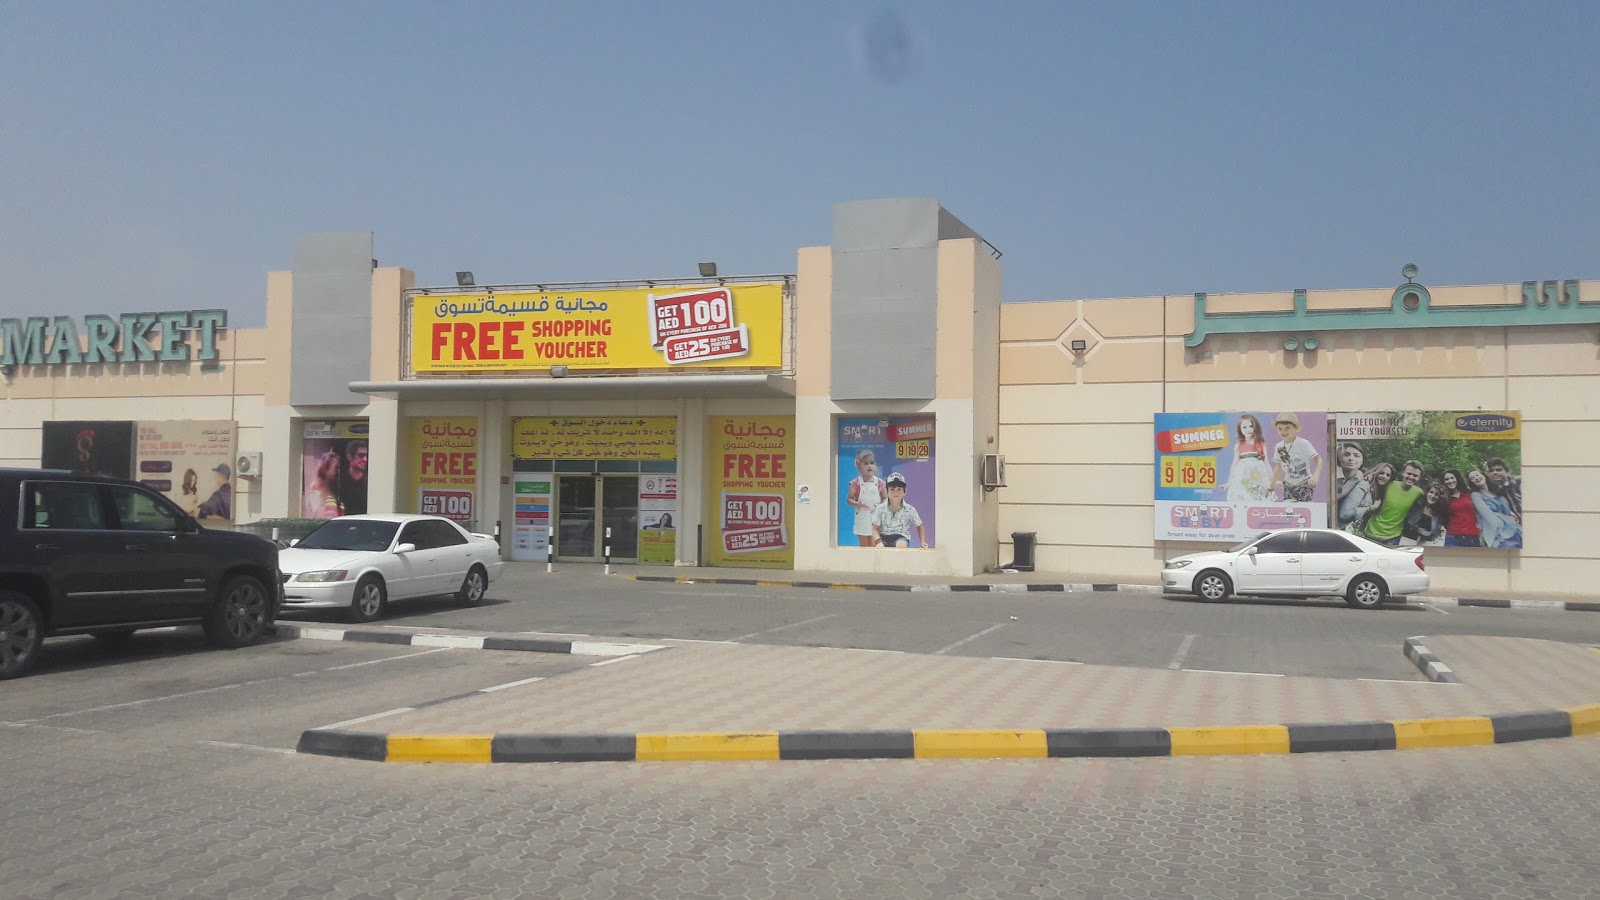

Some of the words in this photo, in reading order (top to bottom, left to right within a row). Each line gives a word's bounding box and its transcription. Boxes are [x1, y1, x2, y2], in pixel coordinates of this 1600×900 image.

[555, 296, 608, 314] مجانية
[658, 305, 678, 318] GET
[680, 298, 726, 326] 100
[1184, 263, 1600, 348] سفير
[532, 319, 612, 338] SHOPPING
[658, 317, 680, 330] AED
[0, 309, 228, 365] MARKET
[432, 321, 524, 360] FREE
[534, 341, 608, 359] VOUCHER
[674, 342, 688, 351] GET
[675, 350, 688, 359] AED
[688, 338, 710, 357] 25
[422, 420, 476, 439] مجانية
[724, 420, 786, 440] مجانية
[898, 424, 932, 436] SUMMER
[1350, 418, 1386, 426] FREEDOM
[1470, 418, 1513, 428] eternity
[1173, 429, 1224, 444] SUMMER
[1370, 427, 1409, 435] YOURSELF
[898, 445, 903, 456] 9
[908, 445, 916, 456] 19
[919, 445, 928, 456] 29
[421, 452, 477, 475] FREE
[724, 454, 786, 478] FREE
[1165, 467, 1174, 483] 9
[1181, 467, 1196, 484] 19
[1199, 467, 1215, 484] 29
[423, 496, 438, 504] GET
[440, 496, 470, 514] 100
[728, 501, 743, 509] GET
[423, 504, 438, 513] AED
[727, 510, 743, 519] AED
[746, 501, 780, 520] 100
[742, 534, 758, 547] 25
